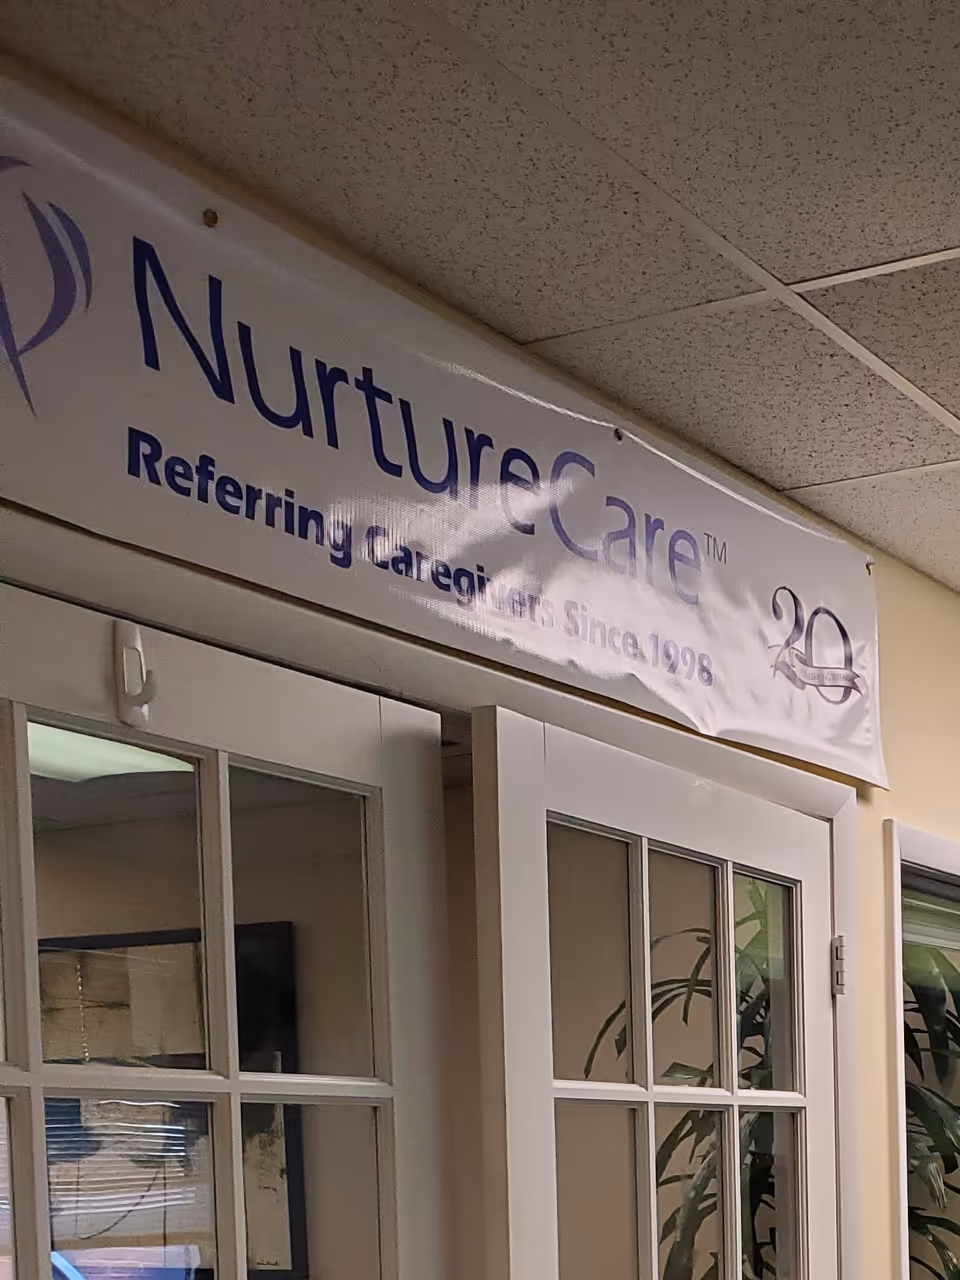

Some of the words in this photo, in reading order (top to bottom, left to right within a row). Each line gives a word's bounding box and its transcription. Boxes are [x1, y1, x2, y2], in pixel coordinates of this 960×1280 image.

[128, 426, 352, 569] Referring
[365, 524, 555, 630] Caregiers
[563, 599, 641, 661] Since
[650, 632, 713, 687] 1998
[133, 236, 701, 607] NurtureCare
